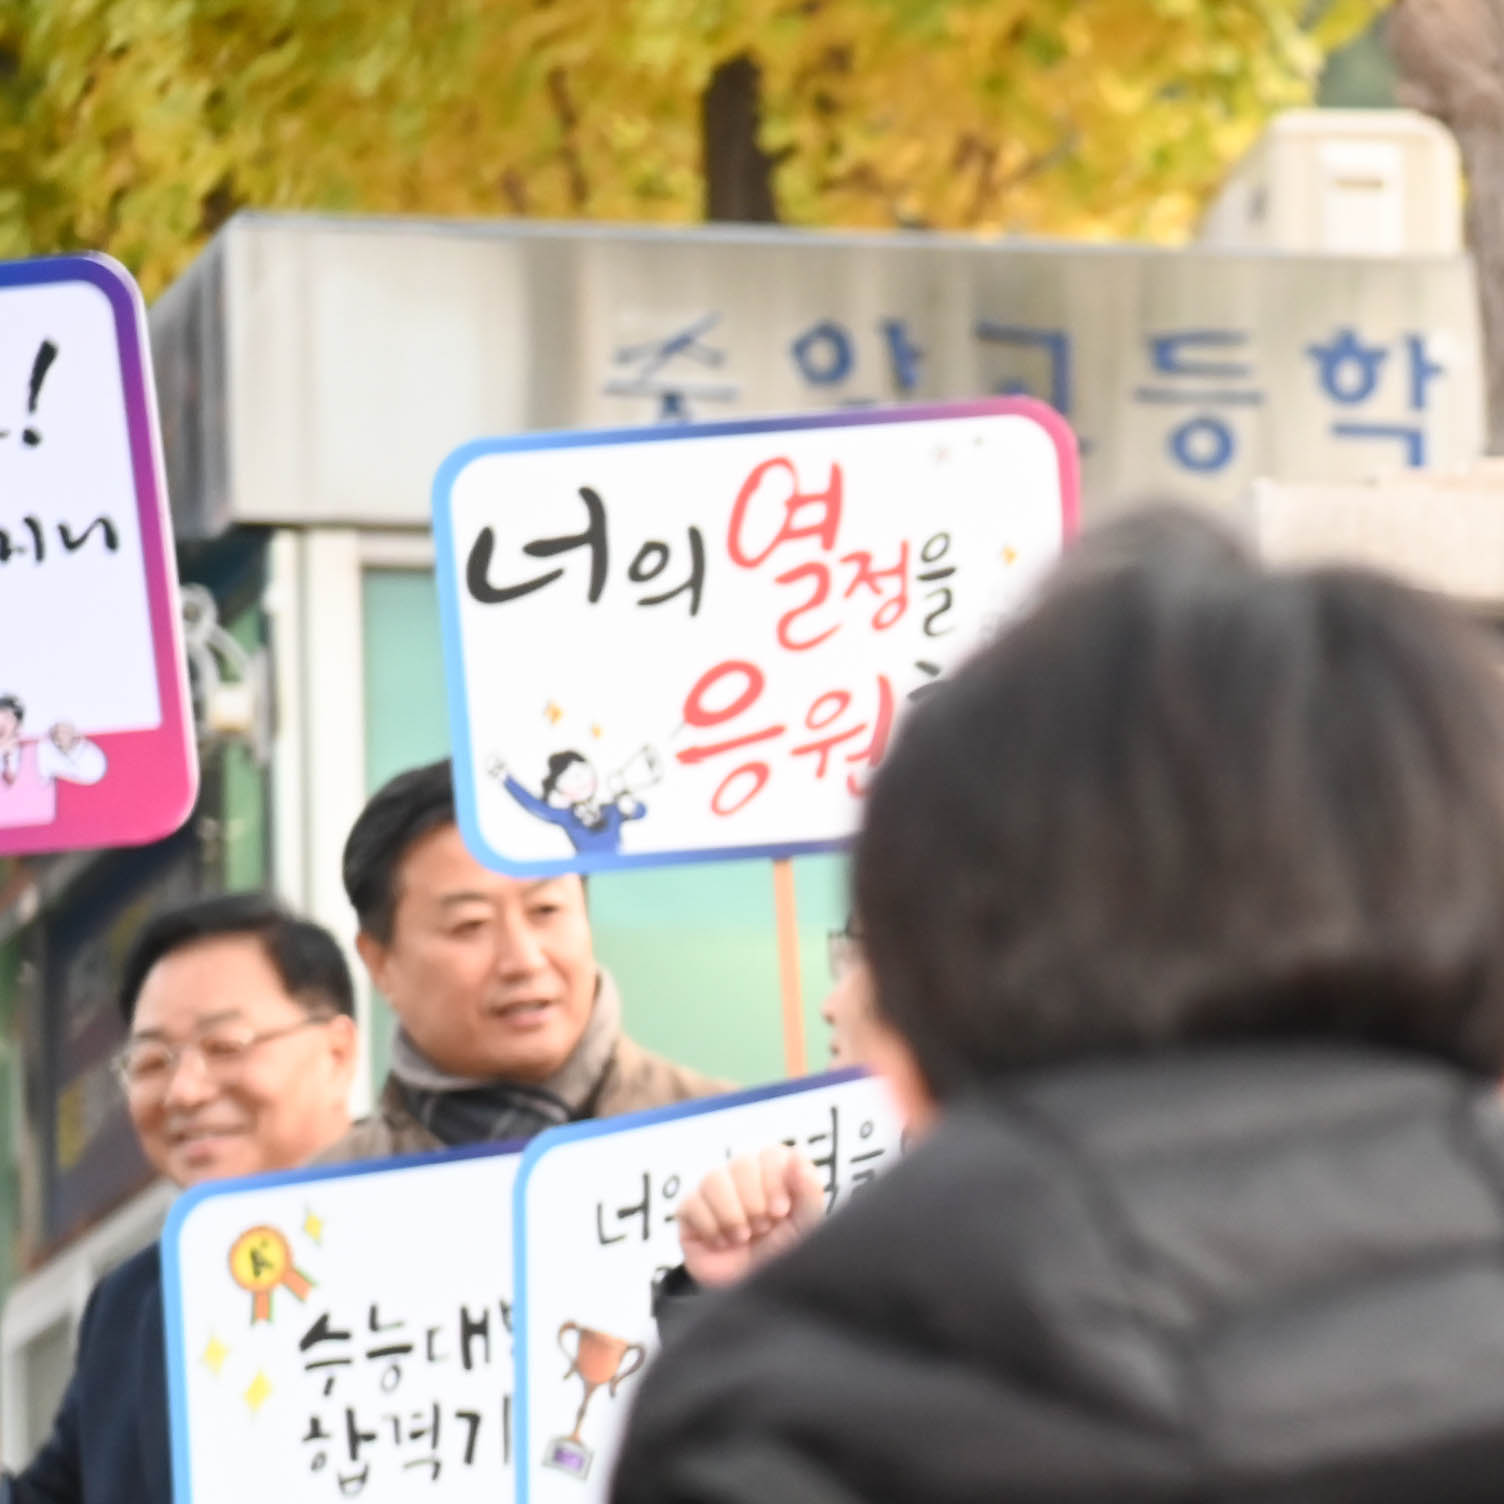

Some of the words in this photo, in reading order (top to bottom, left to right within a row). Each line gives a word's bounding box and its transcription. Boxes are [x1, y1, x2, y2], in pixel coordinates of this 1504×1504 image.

[467, 486, 706, 617] 너의
[727, 456, 957, 651] 열정을
[675, 659, 942, 820] 응원
[300, 1300, 513, 1397] 수능대
